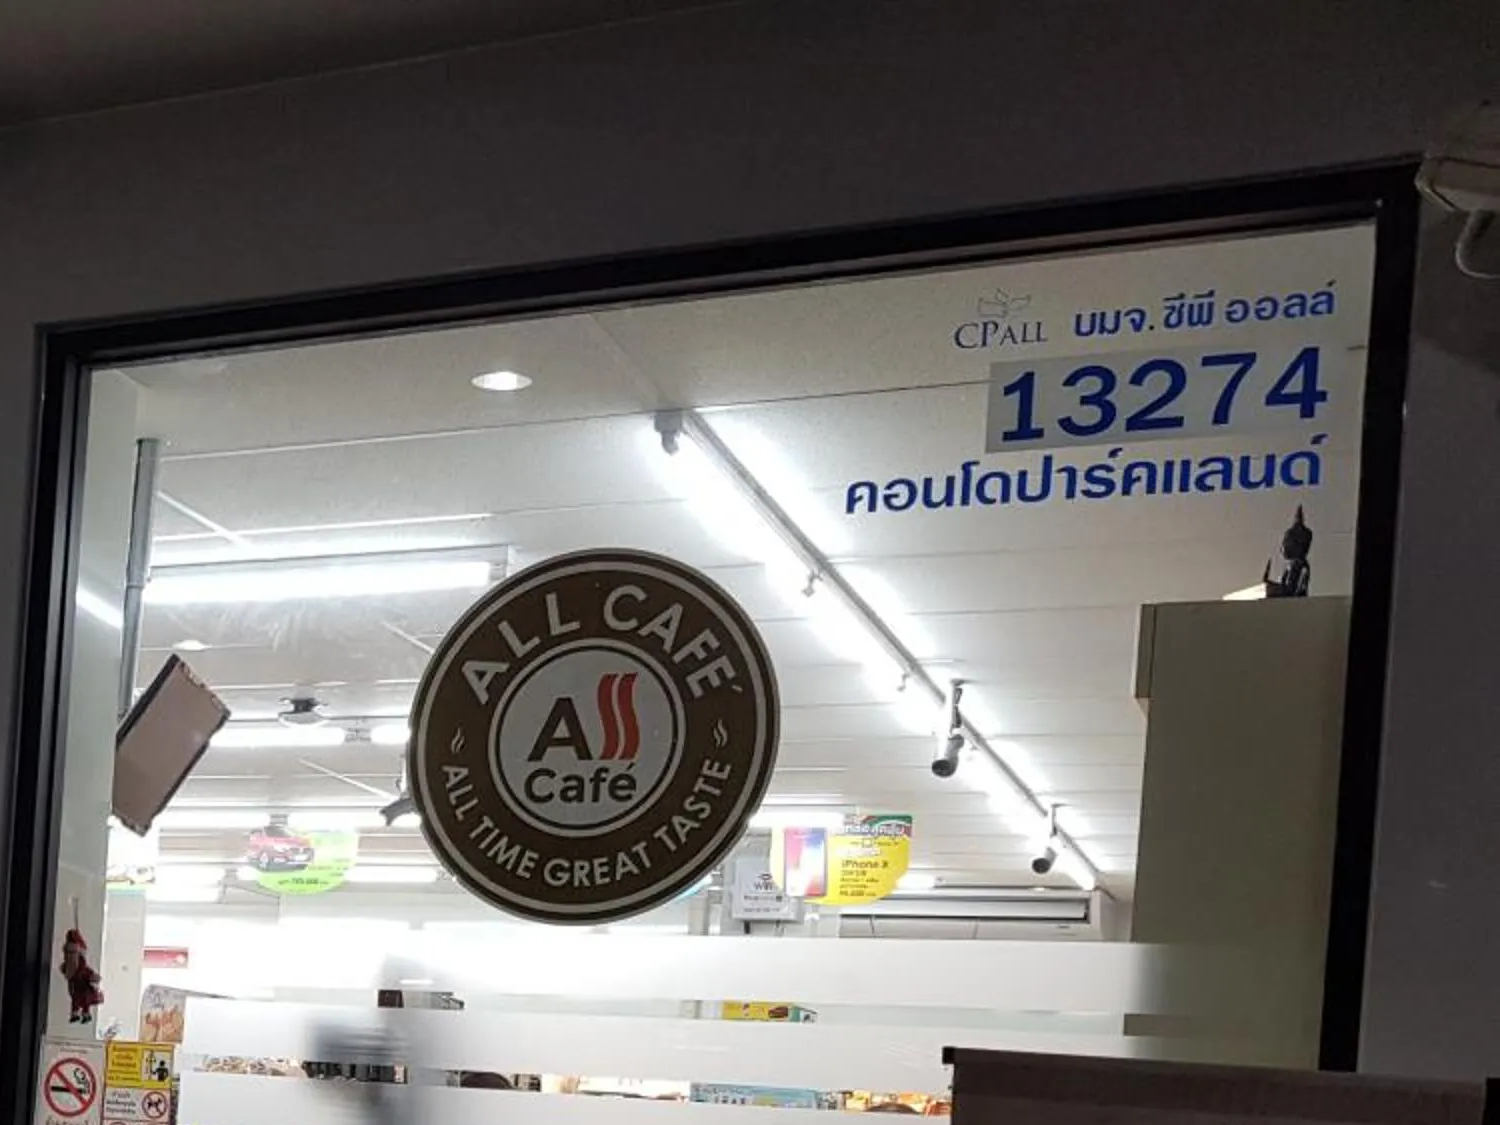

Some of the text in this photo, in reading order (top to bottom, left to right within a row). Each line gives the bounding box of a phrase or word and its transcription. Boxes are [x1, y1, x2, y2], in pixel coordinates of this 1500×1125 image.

[1074, 280, 1337, 337] บมจ. ซีพี ออลล์
[1002, 347, 1328, 442] 13274
[845, 434, 1328, 515] คอนโดปาร์คแลนด์
[462, 592, 580, 705] ALL
[441, 758, 732, 887] ALL TIME GREAT TASTE
[524, 763, 637, 804] Café
